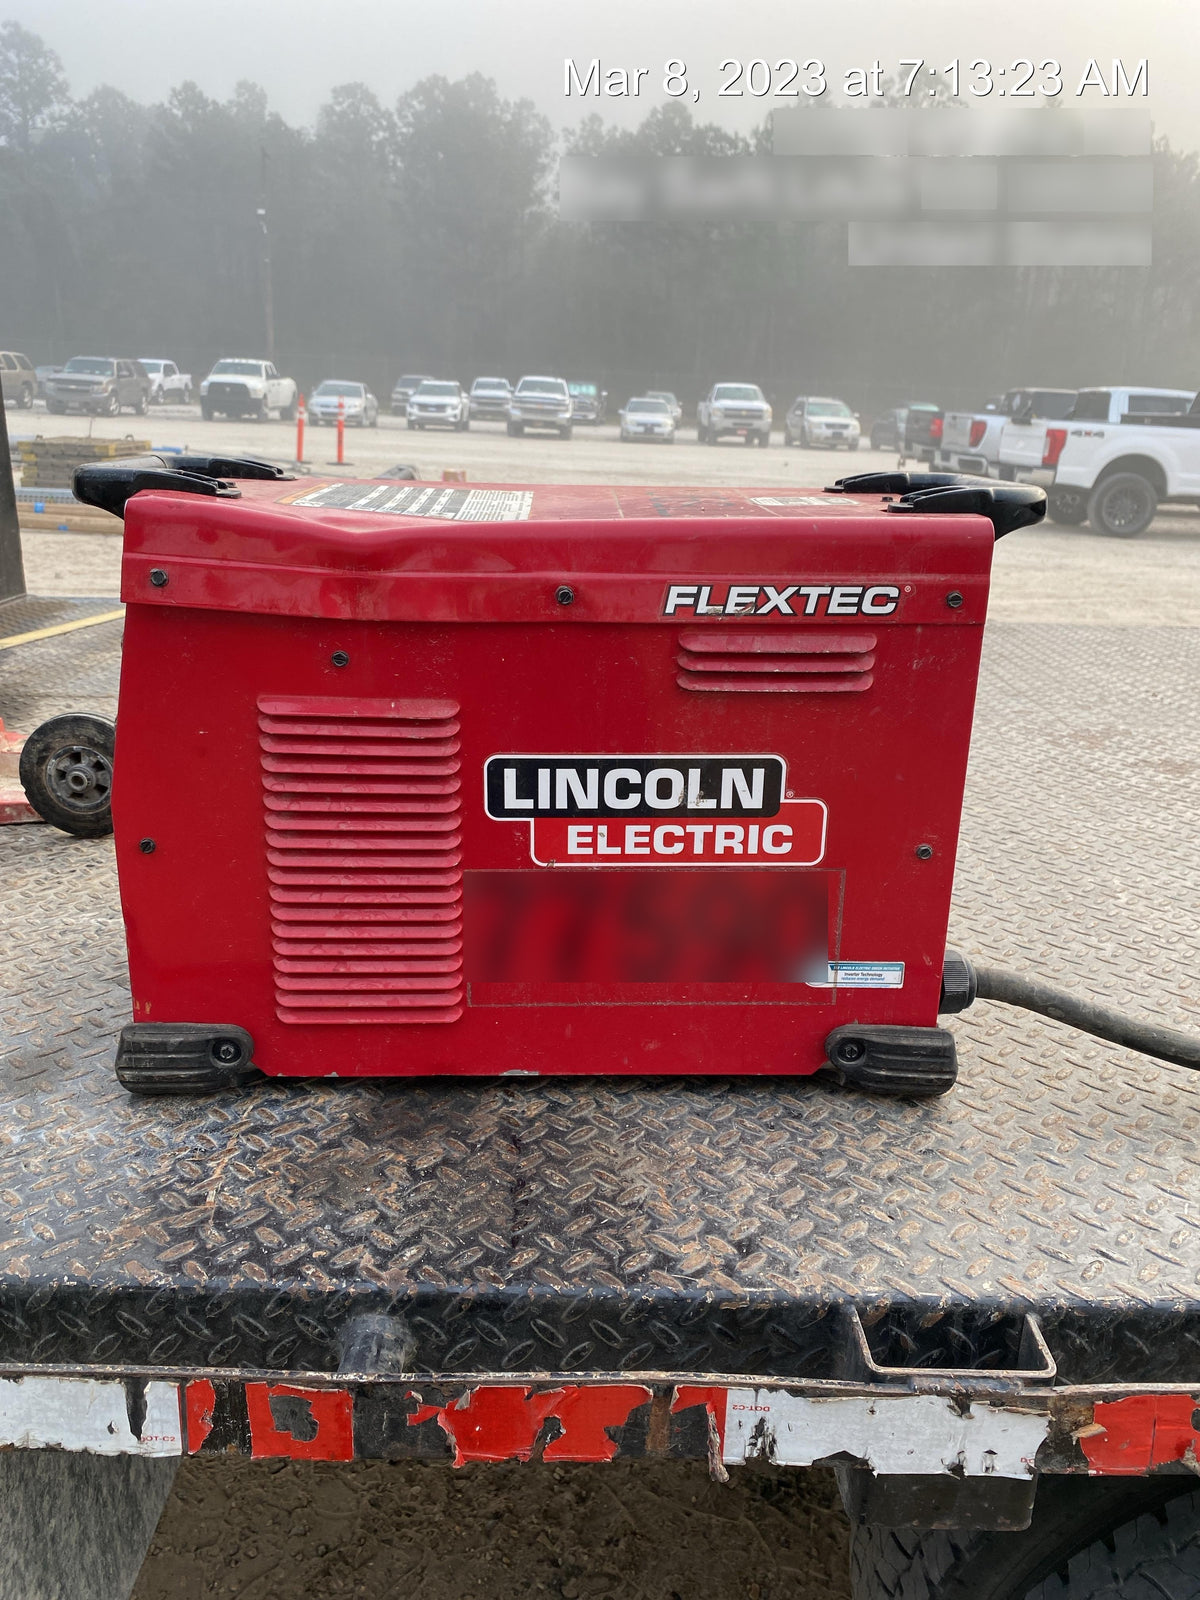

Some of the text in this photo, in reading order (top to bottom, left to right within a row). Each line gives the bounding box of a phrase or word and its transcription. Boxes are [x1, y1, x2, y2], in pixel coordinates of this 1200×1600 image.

[663, 585, 900, 616] FLEXTEC
[503, 768, 765, 809] LINCOLN
[567, 825, 793, 855] ELECTRIC
[732, 1404, 770, 1412] DOT-C2
